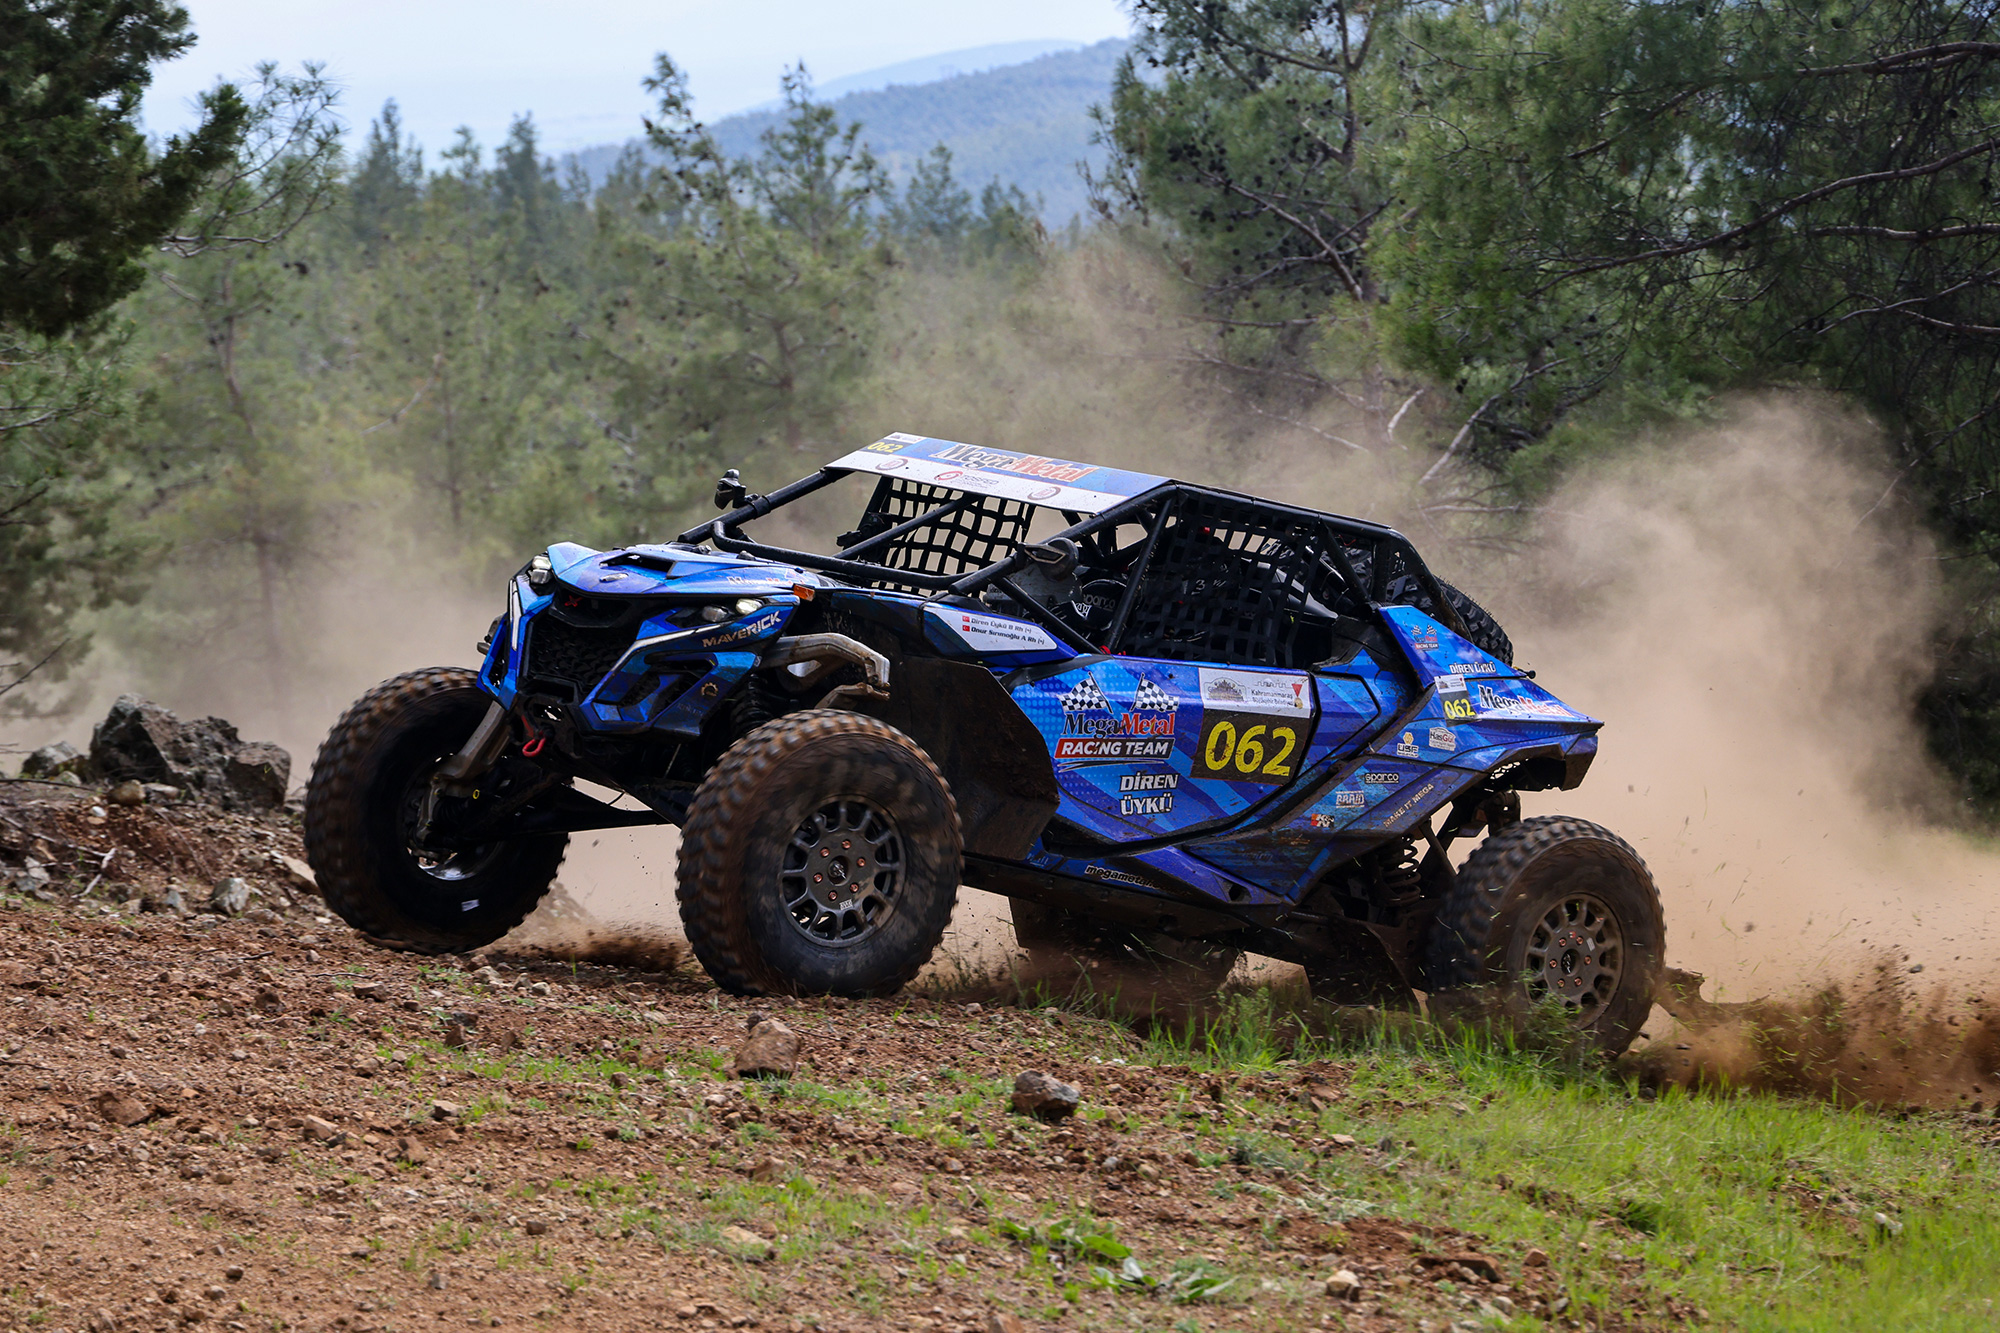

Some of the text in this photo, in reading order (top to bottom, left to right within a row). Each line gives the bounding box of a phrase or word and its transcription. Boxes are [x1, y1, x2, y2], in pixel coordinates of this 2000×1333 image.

[867, 442, 904, 453] 062
[929, 444, 1099, 483] MegaMetal
[702, 610, 781, 648] MAVERICK
[971, 618, 989, 626] Diren
[971, 626, 987, 634] Onur
[1444, 698, 1476, 719] 062
[1061, 713, 1175, 738] MegaMetal
[1061, 741, 1169, 755] RACING TEAM
[1204, 721, 1296, 777] 062
[1120, 772, 1179, 793] DİREN
[1365, 773, 1399, 781] sparco
[1120, 794, 1173, 816] ÜYKÜ
[1336, 793, 1365, 806] BRAID
[1403, 799, 1413, 810] IT
[1412, 783, 1434, 803] MEGA
